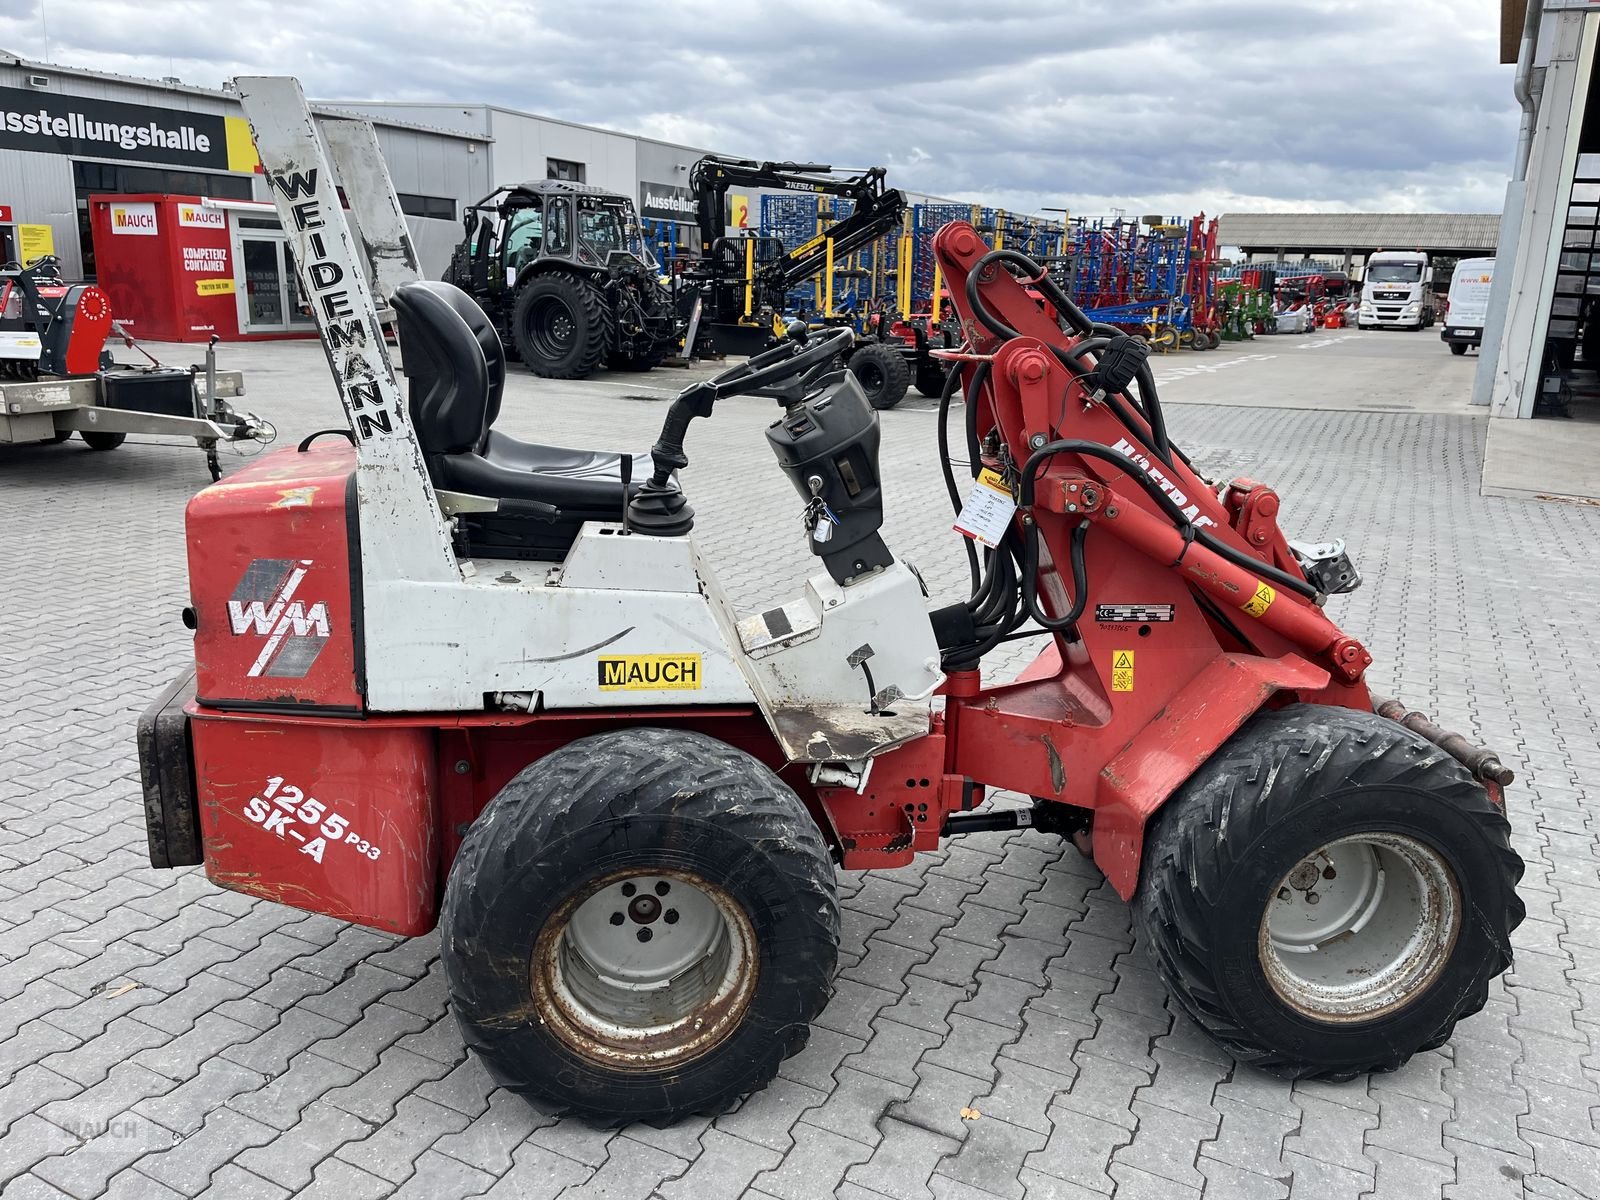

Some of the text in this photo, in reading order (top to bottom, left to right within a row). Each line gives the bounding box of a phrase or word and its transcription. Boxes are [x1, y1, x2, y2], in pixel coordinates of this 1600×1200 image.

[791, 181, 814, 191] KESLA
[117, 213, 154, 228] MAUCH
[185, 211, 221, 223] MAUCH
[739, 205, 748, 227] 2
[183, 247, 227, 260] KOMPETENZ
[184, 260, 225, 272] CONTAINER
[274, 168, 393, 440] WEIDEMANN
[603, 660, 696, 684] MAUCH
[263, 775, 381, 860] 1255 P33
[243, 797, 327, 864] SK-A
